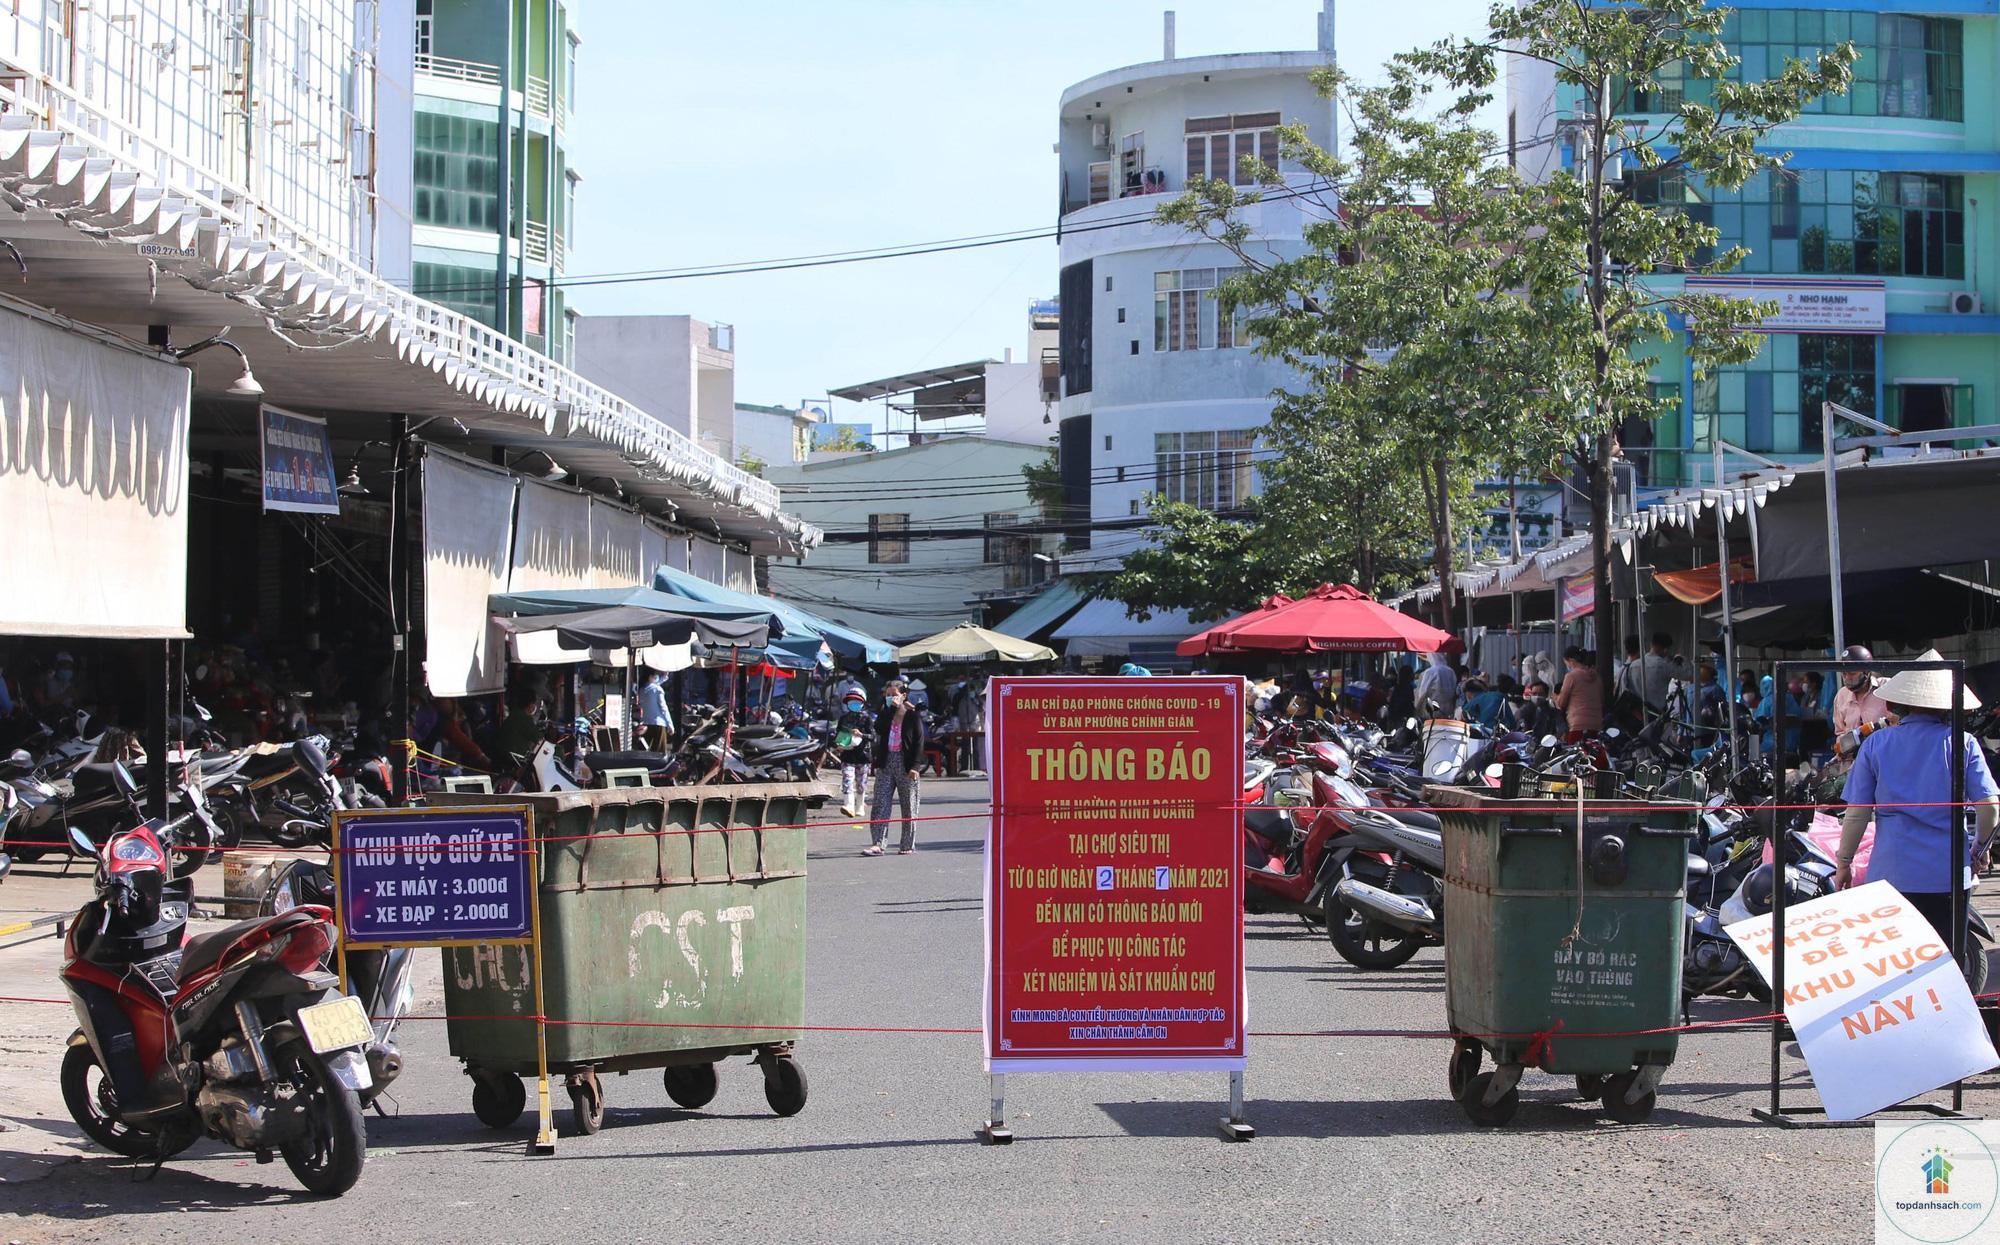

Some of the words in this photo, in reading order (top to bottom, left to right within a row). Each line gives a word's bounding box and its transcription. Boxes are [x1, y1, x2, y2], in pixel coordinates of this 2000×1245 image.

[1366, 641, 1397, 649] COFFEE
[1016, 698, 1039, 710] BAN
[1042, 695, 1060, 710] CHỈ
[1062, 698, 1084, 712] ĐẠO
[1087, 696, 1124, 710] PHÒNG
[1126, 694, 1164, 710] CHỐNG
[1166, 698, 1198, 710] COVID
[1208, 698, 1221, 710] 19
[1043, 714, 1058, 728] ỦY
[1060, 716, 1082, 728] BAN
[1084, 714, 1129, 728] PHƯỜNG
[1132, 715, 1165, 728] CHÍNH
[1026, 741, 1136, 781] THÔNG
[1146, 741, 1211, 781] BÁO
[1044, 799, 1071, 824] TẠM
[1120, 799, 1150, 820] KINH
[1152, 799, 1195, 820] DOANH
[355, 836, 396, 866] KHU
[402, 832, 441, 871] VỰC
[448, 828, 485, 864] GIỮ
[488, 833, 515, 862] XE
[1070, 833, 1090, 858] TẠI
[1092, 832, 1116, 858] CHỢ
[1120, 829, 1148, 854] SIÊU
[1151, 833, 1170, 858] THỊ
[375, 881, 397, 897] XE
[402, 876, 438, 897] MÁY
[452, 877, 508, 895] 3.000đ
[1008, 864, 1025, 889] TỪ
[1037, 864, 1059, 889] GIỜ
[1061, 864, 1094, 889] NGÀY
[1100, 869, 1113, 887] 2
[1114, 864, 1156, 889] THÁNG
[1156, 868, 1168, 887] 7
[1168, 864, 1197, 889] NĂM
[1200, 868, 1229, 888] 2021
[376, 906, 398, 923] XE
[402, 905, 436, 926] ĐẠP
[453, 903, 509, 922] 2.000đ
[1036, 896, 1061, 923] ĐẾN
[1064, 902, 1085, 923] KHI
[1088, 898, 1104, 923] CÓ
[1108, 898, 1148, 923] THÔNG
[1151, 898, 1176, 923] BÁO
[1178, 898, 1203, 923] MỚI
[1755, 904, 1902, 956] KHÔNG
[1052, 930, 1070, 958] ĐỂ
[1072, 937, 1105, 961] PHỤC
[1107, 937, 1123, 961] VỤ
[1126, 932, 1161, 958] CÔNG
[1162, 932, 1186, 958] TÁC
[1802, 936, 1848, 966] ĐỂ
[1857, 926, 1903, 949] XE
[1023, 967, 1046, 992] XÉT
[1049, 967, 1098, 996] NGHIỆM
[1101, 967, 1116, 992] VÀ
[1120, 966, 1144, 992] SÁT
[1146, 964, 1188, 992] KHUẨN
[1190, 969, 1216, 996] CHỢ
[1784, 969, 1856, 1007] KHU
[1864, 943, 1944, 978] VỰC
[1010, 1008, 1032, 1022] KÍNH
[1032, 1009, 1057, 1022] MONG
[1057, 1008, 1070, 1022] BÀ
[1070, 1009, 1086, 1022] CON
[1138, 1007, 1151, 1022] VÀ
[1151, 1007, 1174, 1022] NHÂN
[1174, 1007, 1192, 1022] DÂN
[1208, 1007, 1226, 1022] TÁC
[1840, 995, 1916, 1041] NÀY
[1069, 1027, 1085, 1039] XIN
[1086, 1025, 1108, 1039] CHÂN
[1108, 1025, 1135, 1039] THÀNH
